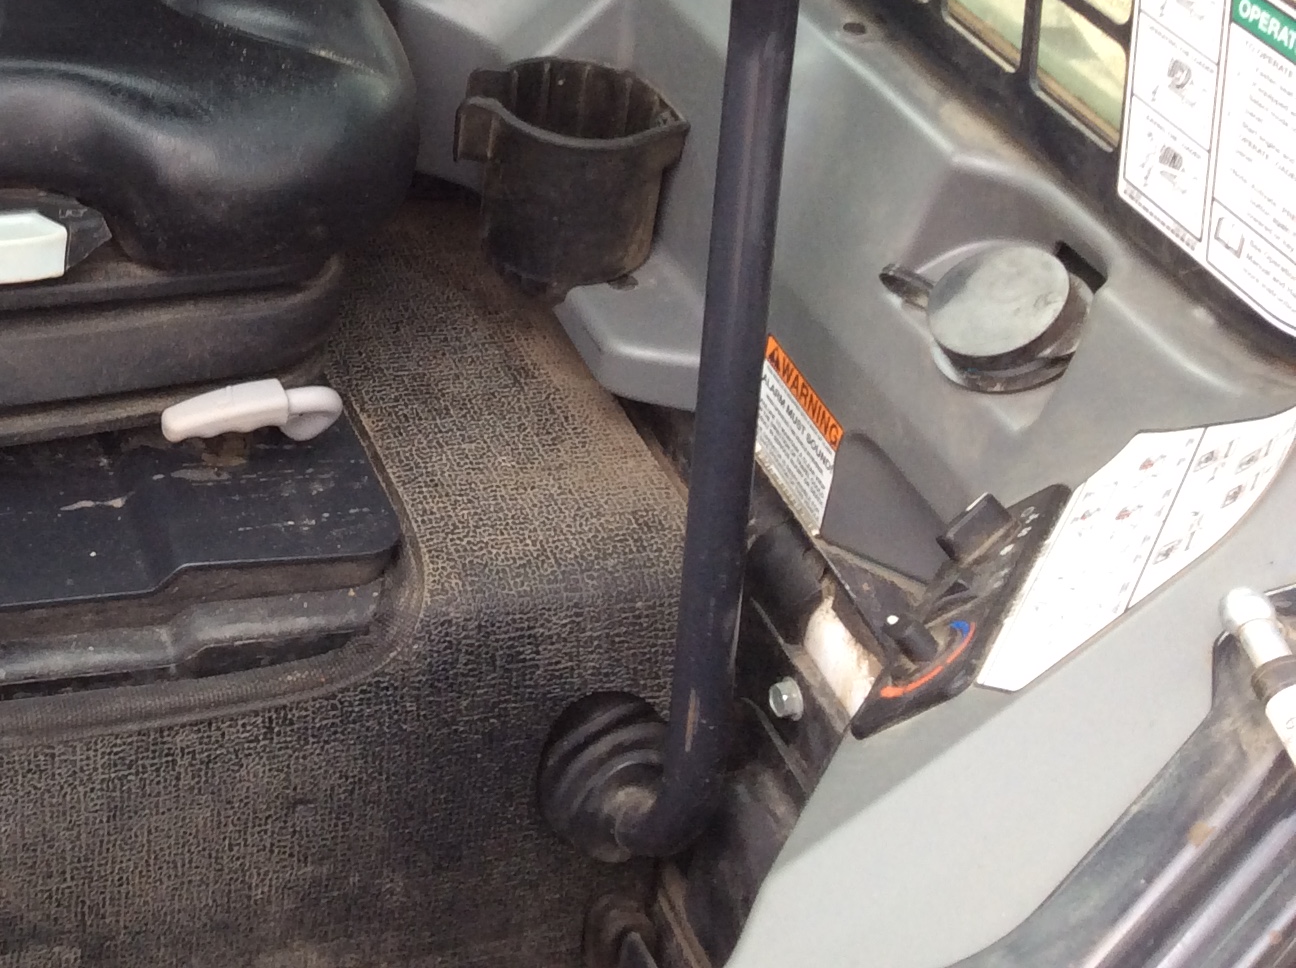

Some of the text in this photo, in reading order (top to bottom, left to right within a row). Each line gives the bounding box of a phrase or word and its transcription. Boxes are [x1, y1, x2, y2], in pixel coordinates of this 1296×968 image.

[762, 374, 786, 406] ALARM
[786, 404, 806, 434] MUST
[781, 354, 838, 445] WARNING
